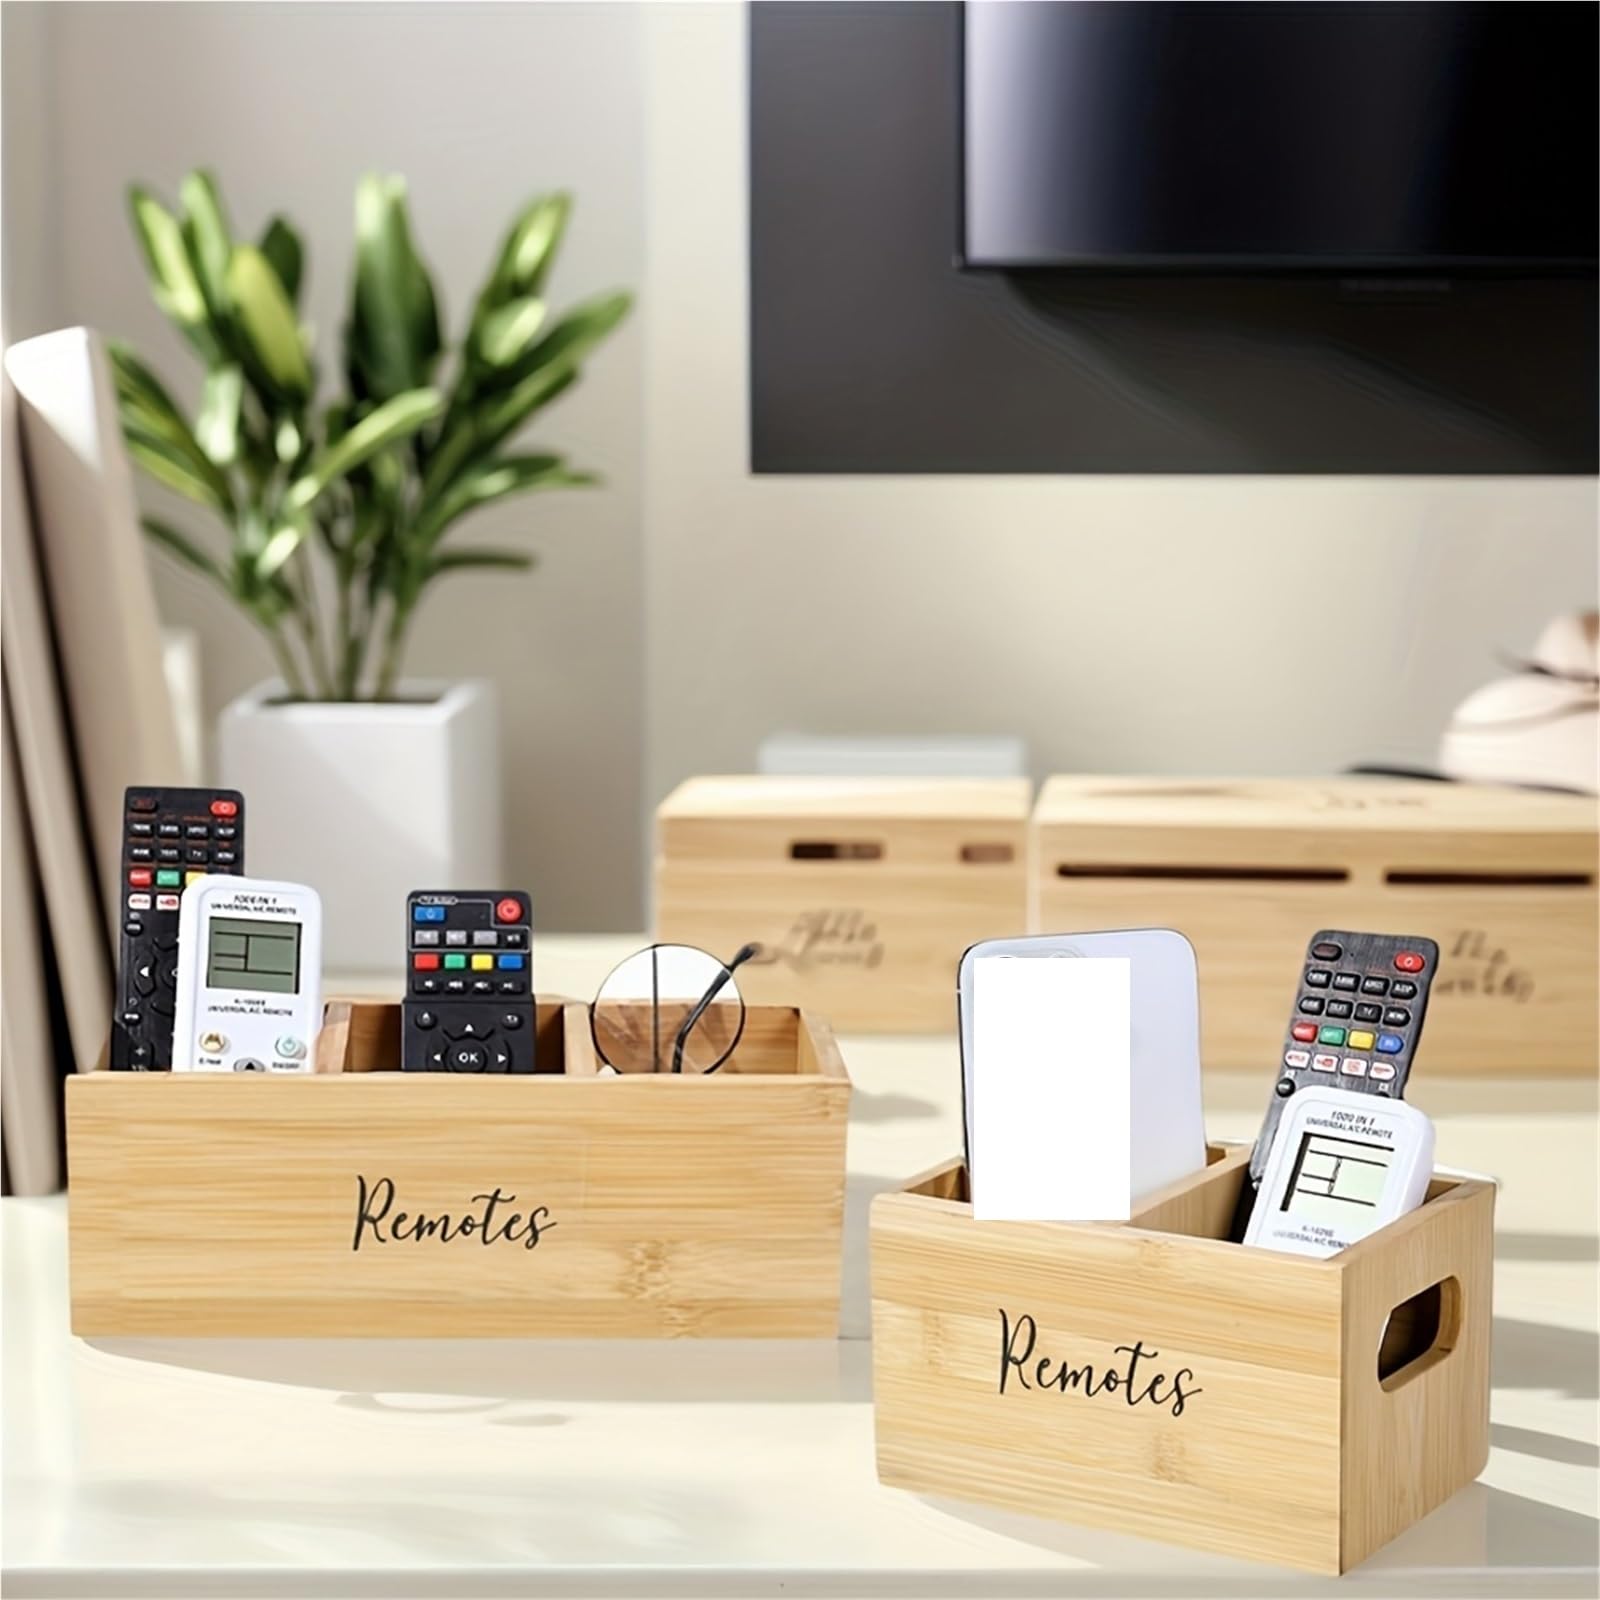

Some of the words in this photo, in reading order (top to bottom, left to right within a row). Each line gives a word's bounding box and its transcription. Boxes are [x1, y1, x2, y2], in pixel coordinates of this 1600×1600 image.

[458, 1052, 479, 1063] OK
[353, 1175, 558, 1251] Remotes
[998, 1308, 1203, 1417] Remotes
